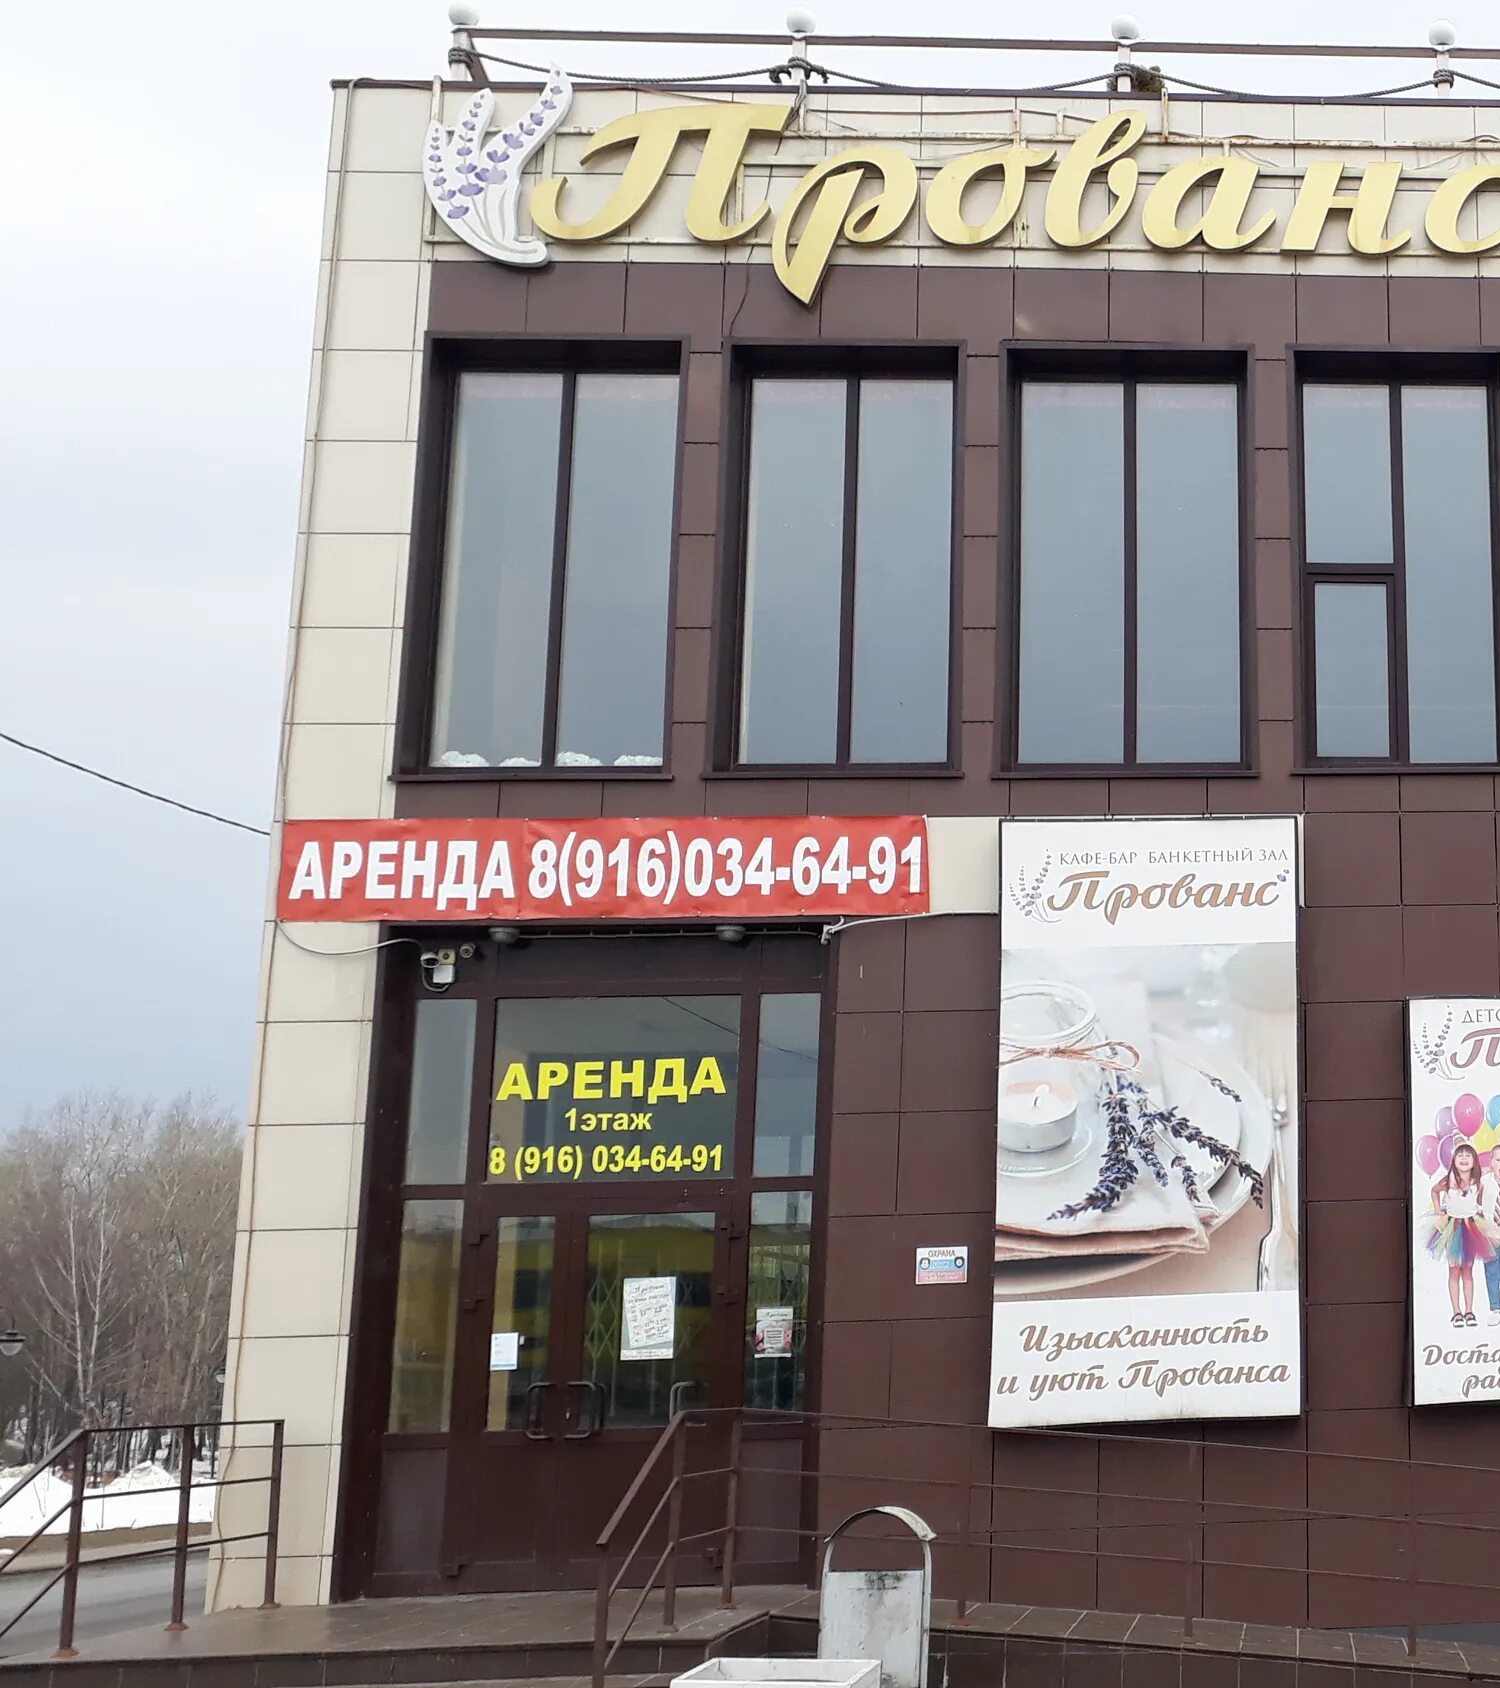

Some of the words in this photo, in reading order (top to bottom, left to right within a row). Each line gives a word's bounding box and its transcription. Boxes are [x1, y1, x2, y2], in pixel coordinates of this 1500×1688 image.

[288, 839, 516, 912] АРЕНДА
[528, 830, 923, 907] 8(916)034-64-91
[1059, 851, 1138, 866] КАФЕ-БАР
[1148, 847, 1254, 864] БАНКЕТНЫЙ
[1258, 848, 1289, 862] ЗАЛ
[1046, 870, 1280, 926] Прованс
[495, 1056, 727, 1105] АРЕНДА
[564, 1107, 653, 1132] 1этаж
[489, 1147, 506, 1175] 8
[514, 1145, 584, 1181] (916)
[592, 1144, 723, 1174] 034-64-91
[1018, 1318, 1270, 1362] Изысканность
[996, 1375, 1020, 1395] и
[1029, 1364, 1109, 1401] уют
[1117, 1359, 1292, 1399] Прованса
